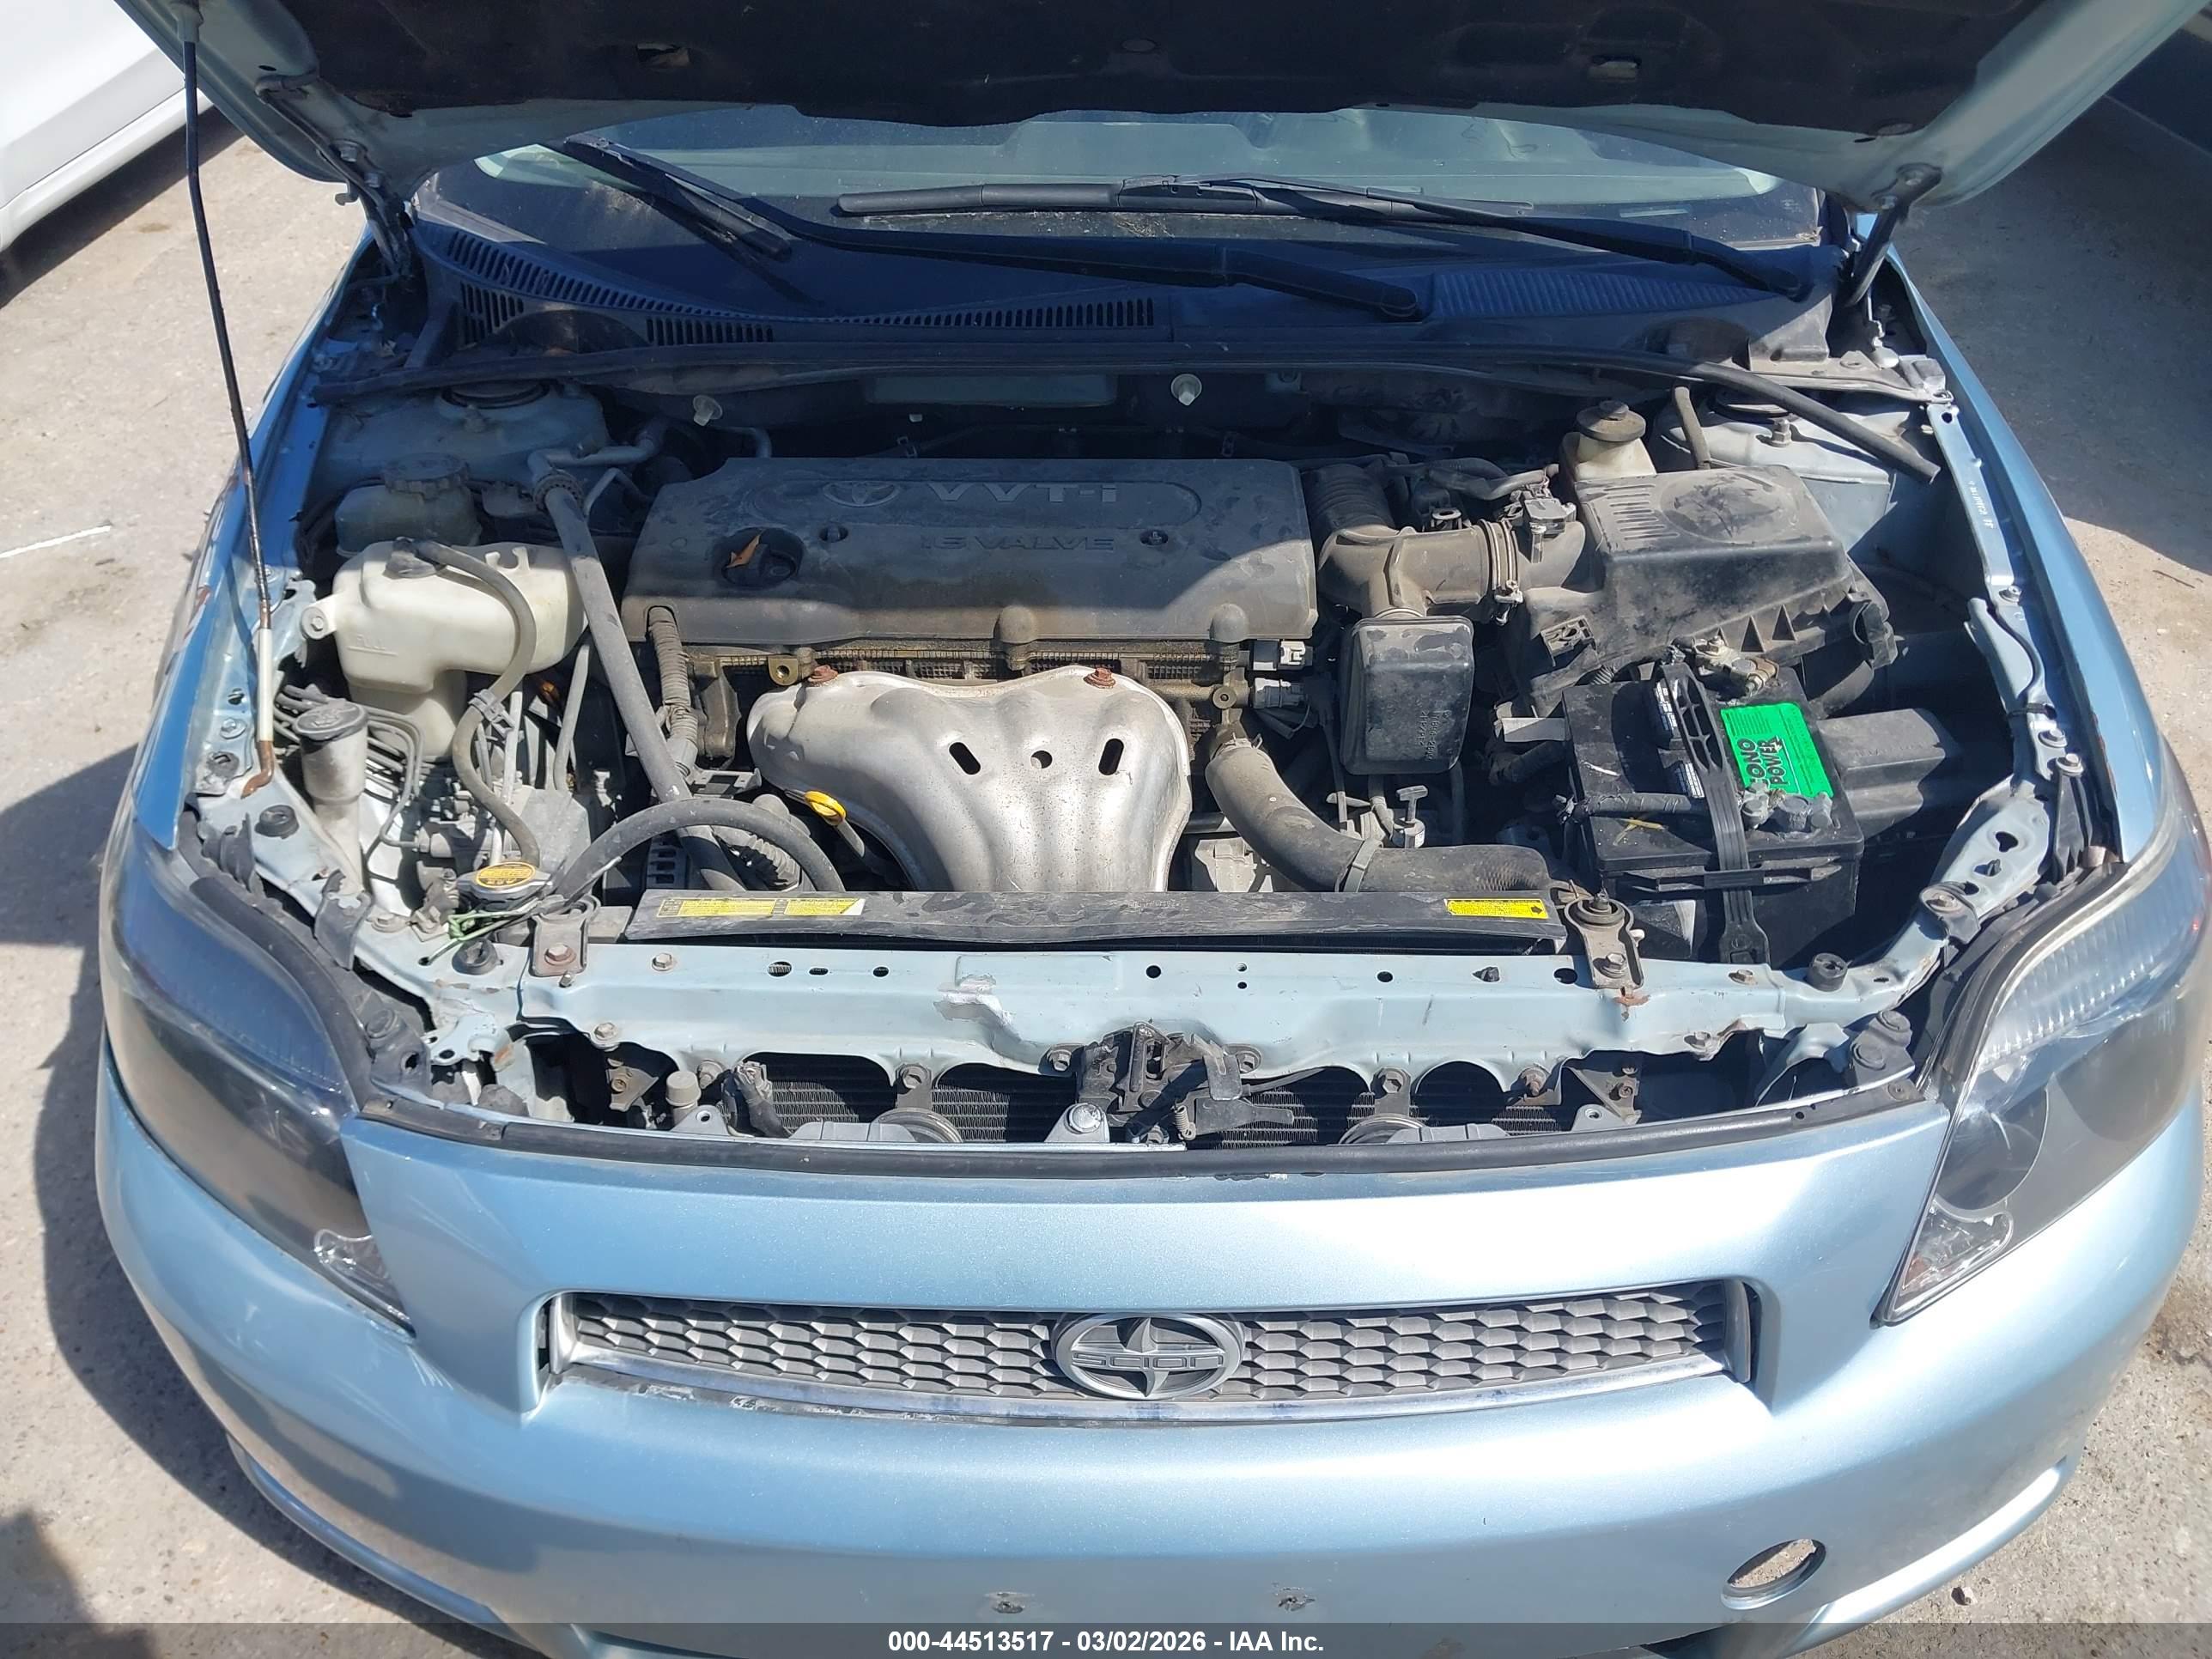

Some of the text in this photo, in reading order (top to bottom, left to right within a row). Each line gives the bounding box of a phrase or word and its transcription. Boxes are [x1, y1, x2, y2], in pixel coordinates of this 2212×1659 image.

[927, 482, 1118, 503] VVT-i
[974, 535, 1115, 551] VALVE
[1757, 736, 1790, 785] POWER
